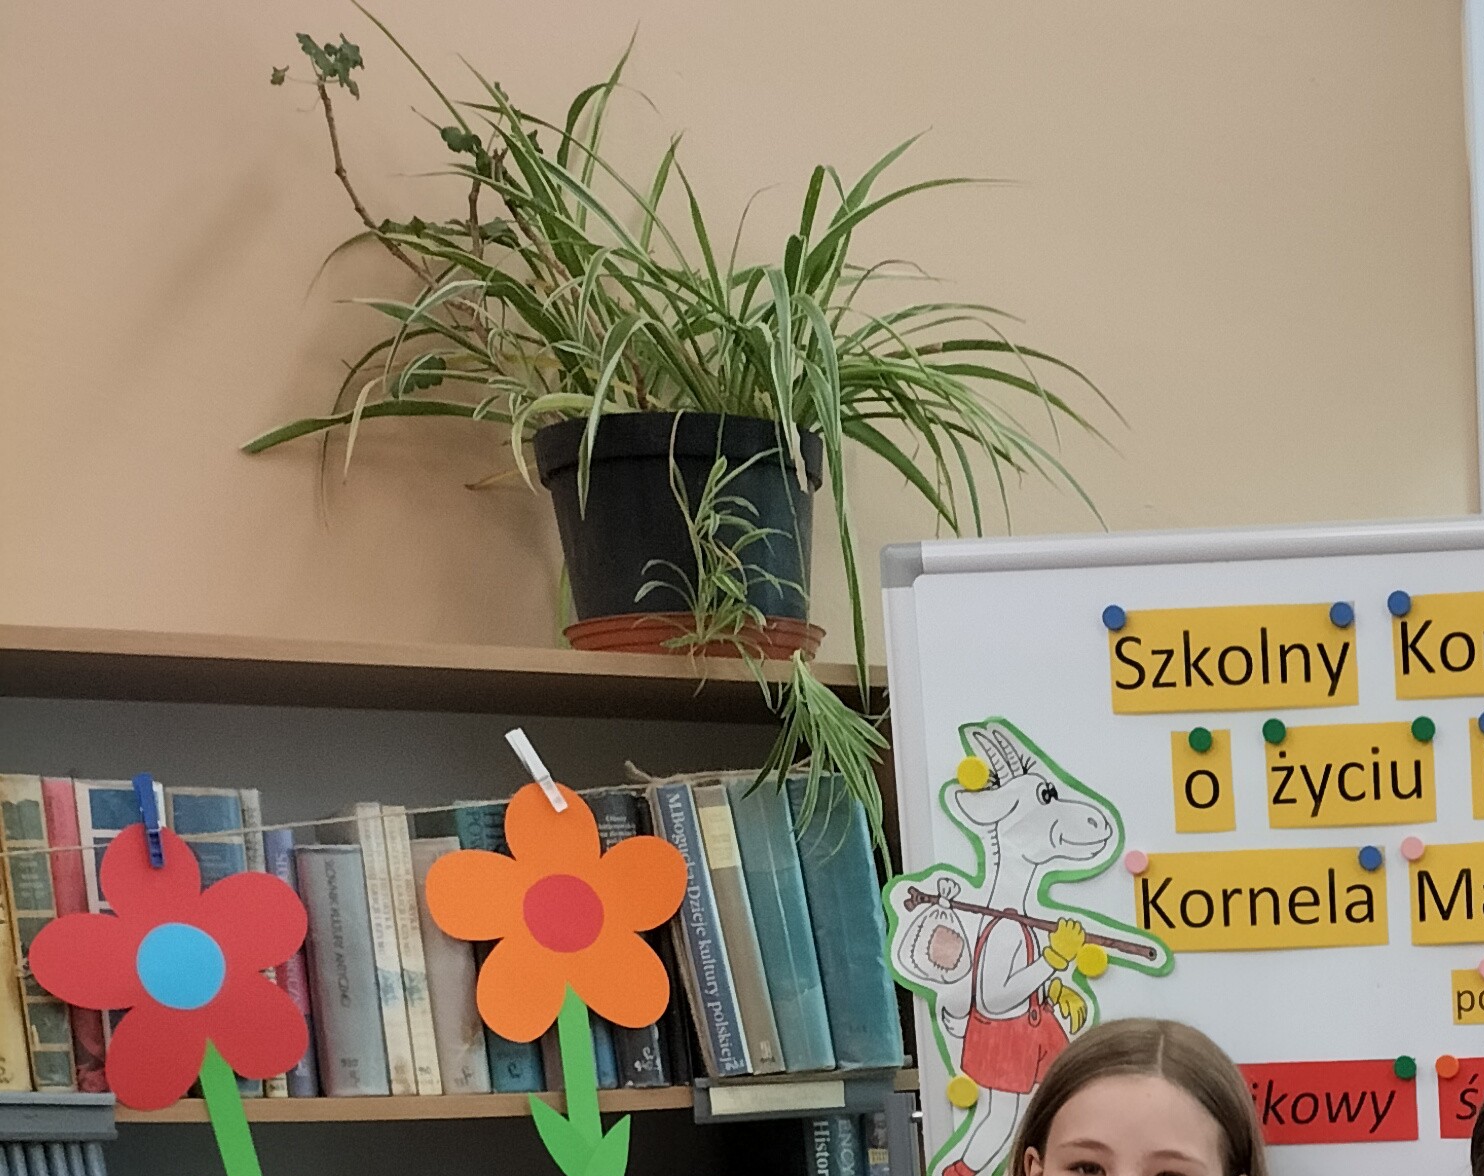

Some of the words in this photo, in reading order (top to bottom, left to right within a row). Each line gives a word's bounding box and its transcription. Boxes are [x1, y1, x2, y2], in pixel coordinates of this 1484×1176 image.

[1114, 627, 1351, 697] Szkolny
[1185, 768, 1220, 810] o
[1271, 747, 1424, 817] życiu
[1141, 869, 1376, 930] Kornela
[699, 939, 720, 995] kultury
[708, 1001, 733, 1071] polskiej
